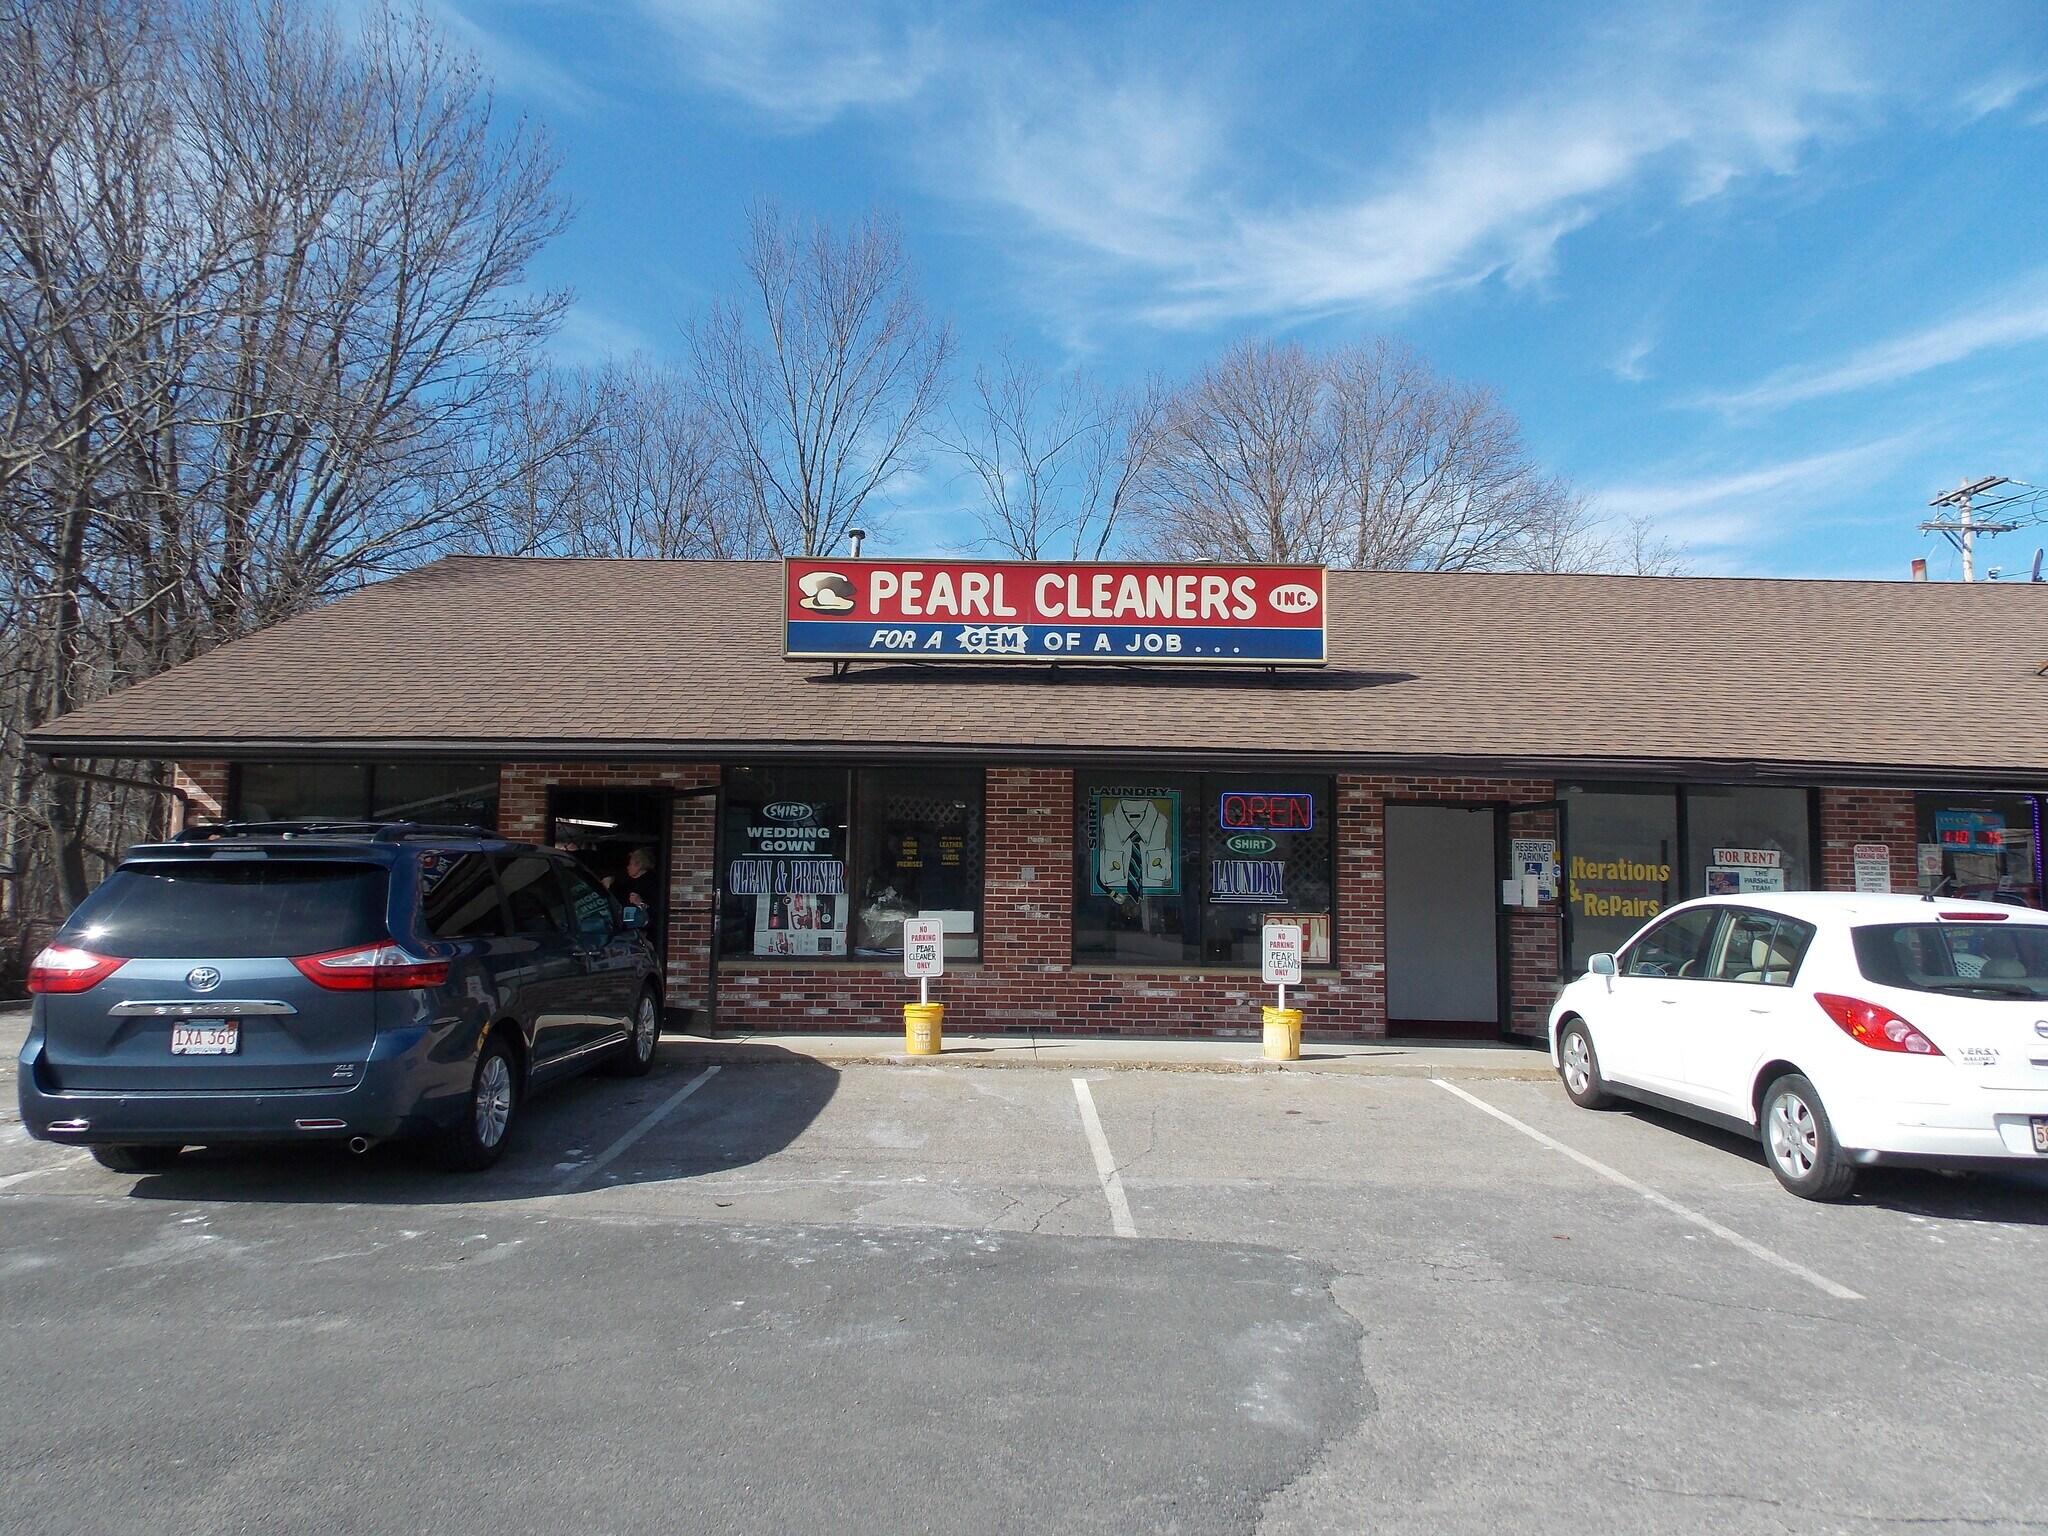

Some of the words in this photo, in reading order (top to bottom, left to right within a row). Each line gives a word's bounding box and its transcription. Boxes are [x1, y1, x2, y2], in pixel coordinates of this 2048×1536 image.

[869, 570, 1017, 617] PEARL
[1035, 573, 1257, 620] CLEANERS
[1276, 591, 1312, 606] INC.
[869, 629, 917, 649] FOR
[923, 630, 943, 649] A
[967, 632, 1018, 648] GEM
[1043, 632, 1081, 651] OF
[1093, 633, 1112, 651] A
[1125, 633, 1182, 652] JOB
[1088, 786, 1170, 797] LAUNDRY
[769, 803, 806, 818] SHIRT
[1225, 795, 1309, 827] OPEN
[1087, 798, 1098, 850] SHIRT
[746, 827, 830, 839] WEDDING
[760, 840, 816, 852] GOWN
[1234, 839, 1268, 850] SHIRT
[1515, 842, 1552, 853] RESERVED
[1856, 845, 1887, 853] CUSTOMER
[1517, 852, 1549, 862] PARKING
[1718, 851, 1740, 863] FOR
[1744, 852, 1775, 864] RENT
[1855, 852, 1876, 860] PARKING
[1570, 856, 1670, 881] lterations
[729, 860, 773, 895] CLEAN
[774, 860, 788, 895] &
[790, 860, 845, 895] PRESER
[1212, 860, 1286, 895] LAUNDRY
[919, 925, 928, 933] NO
[911, 934, 936, 942] PARKING
[1277, 932, 1286, 940] NO
[916, 944, 936, 953] PEARL
[1269, 940, 1295, 949] PARKING
[909, 952, 937, 961] CLEANER
[1271, 951, 1297, 961] PEARL
[916, 961, 931, 970] ONLY
[1274, 968, 1289, 977] ONLY
[174, 1028, 202, 1046] 1XA
[207, 1028, 236, 1045] 368
[914, 1030, 931, 1043] DO
[914, 1042, 931, 1050] THIS
[1957, 1047, 2000, 1056] VERSA
